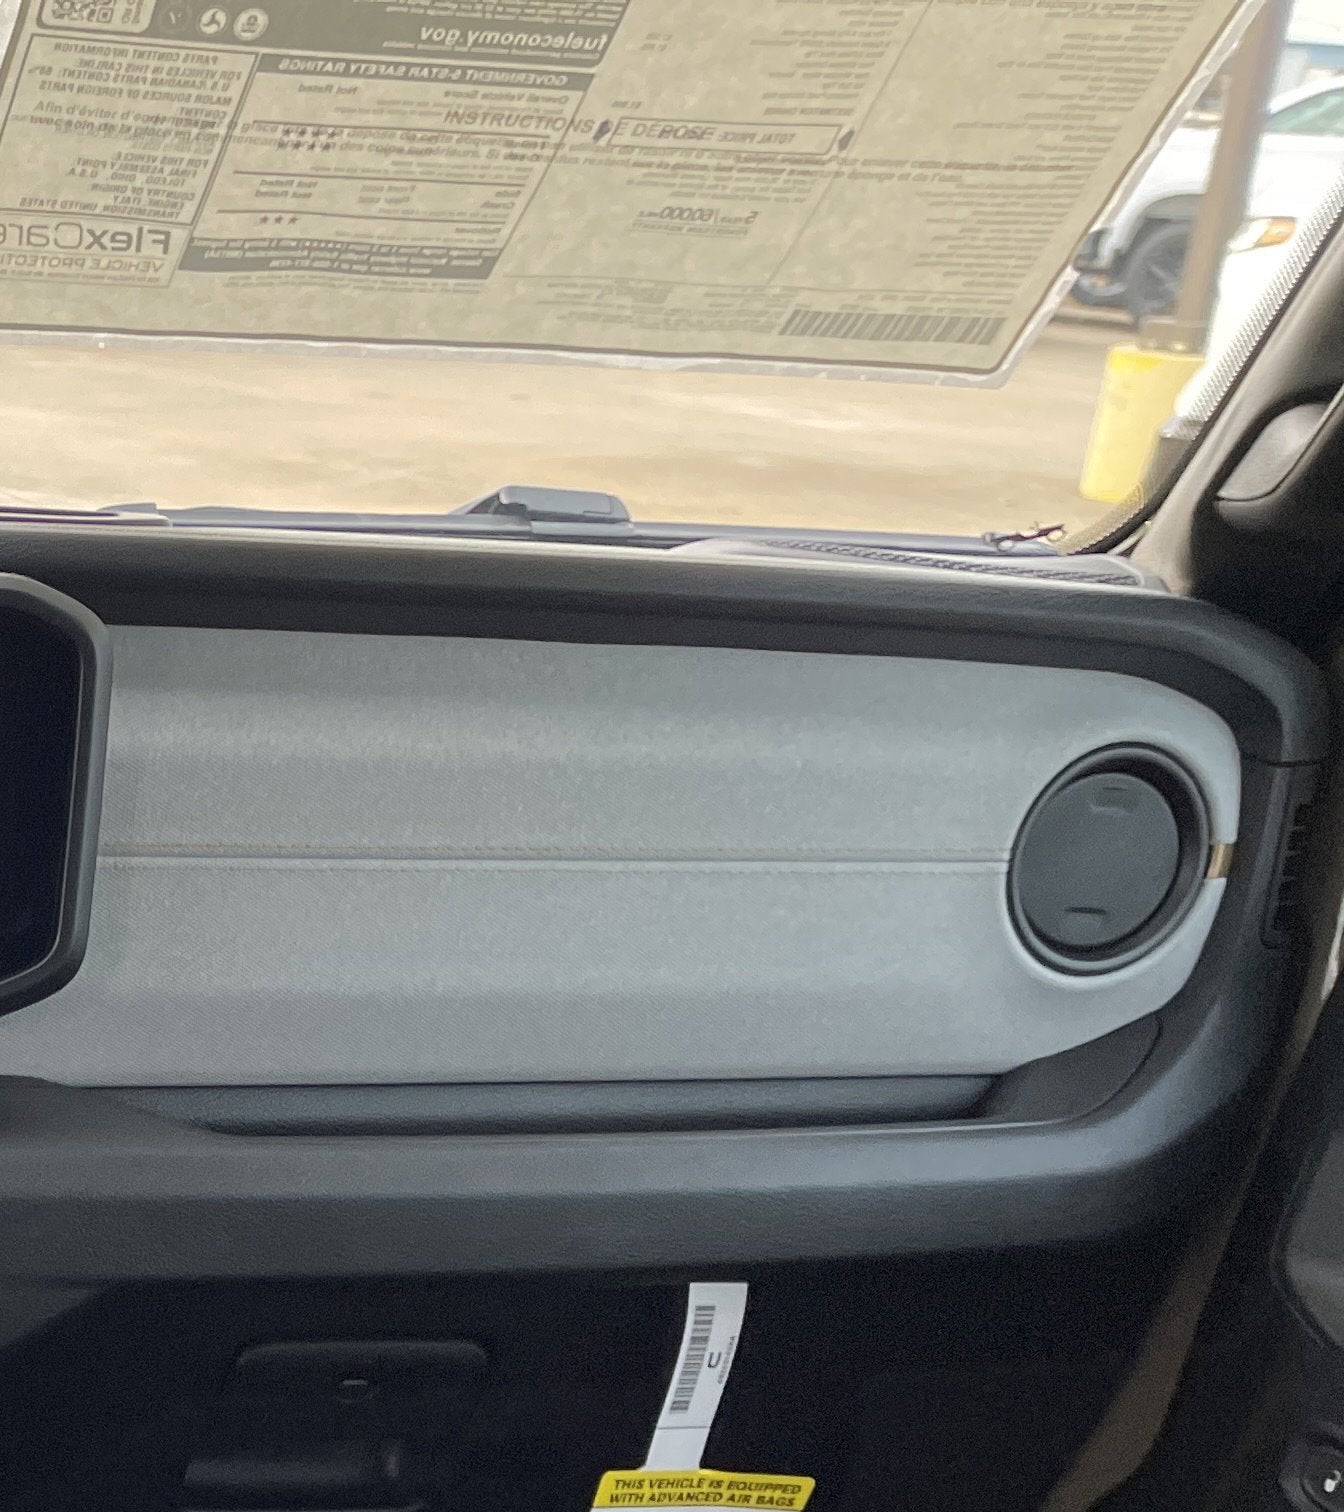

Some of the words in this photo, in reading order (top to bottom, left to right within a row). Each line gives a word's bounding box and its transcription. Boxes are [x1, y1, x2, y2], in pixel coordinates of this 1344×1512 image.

[444, 110, 595, 134] INSTRUCTIONS
[614, 1478, 646, 1490] THIS
[648, 1478, 705, 1490] VEHICLE
[727, 1480, 802, 1495] EQUIPPED
[609, 1492, 644, 1503] WITH
[648, 1492, 723, 1503] ADVANCED
[726, 1493, 751, 1504] AIR
[755, 1494, 795, 1507] BAGS
